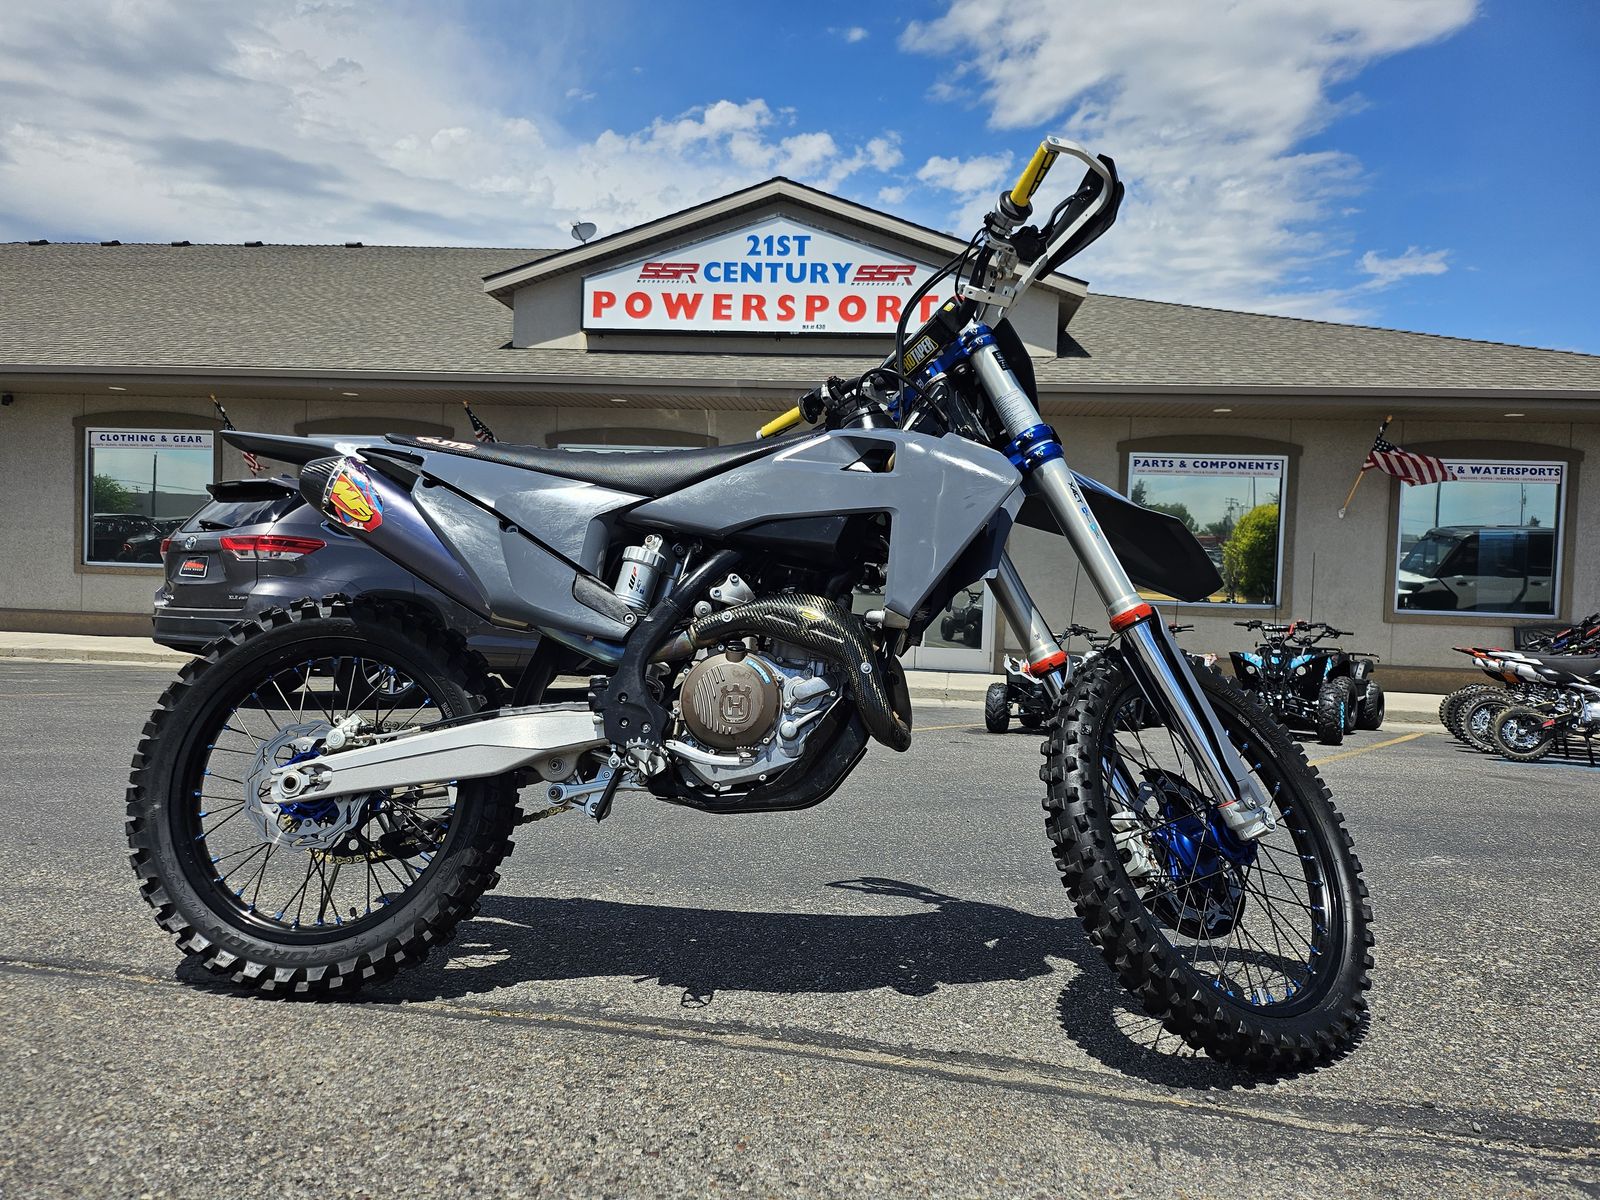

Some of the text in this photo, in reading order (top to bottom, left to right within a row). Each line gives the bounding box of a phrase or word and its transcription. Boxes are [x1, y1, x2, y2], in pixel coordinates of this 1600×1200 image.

[746, 234, 812, 257] 21ST
[639, 263, 700, 284] SSR
[703, 261, 853, 285] CENTURY
[853, 265, 917, 286] SSR
[99, 434, 203, 443] CLOTHING & GEAR
[1133, 459, 1280, 470] PARTS & COMPONENTS
[1457, 466, 1466, 474] &
[1470, 466, 1561, 476] WATERSPORTS
